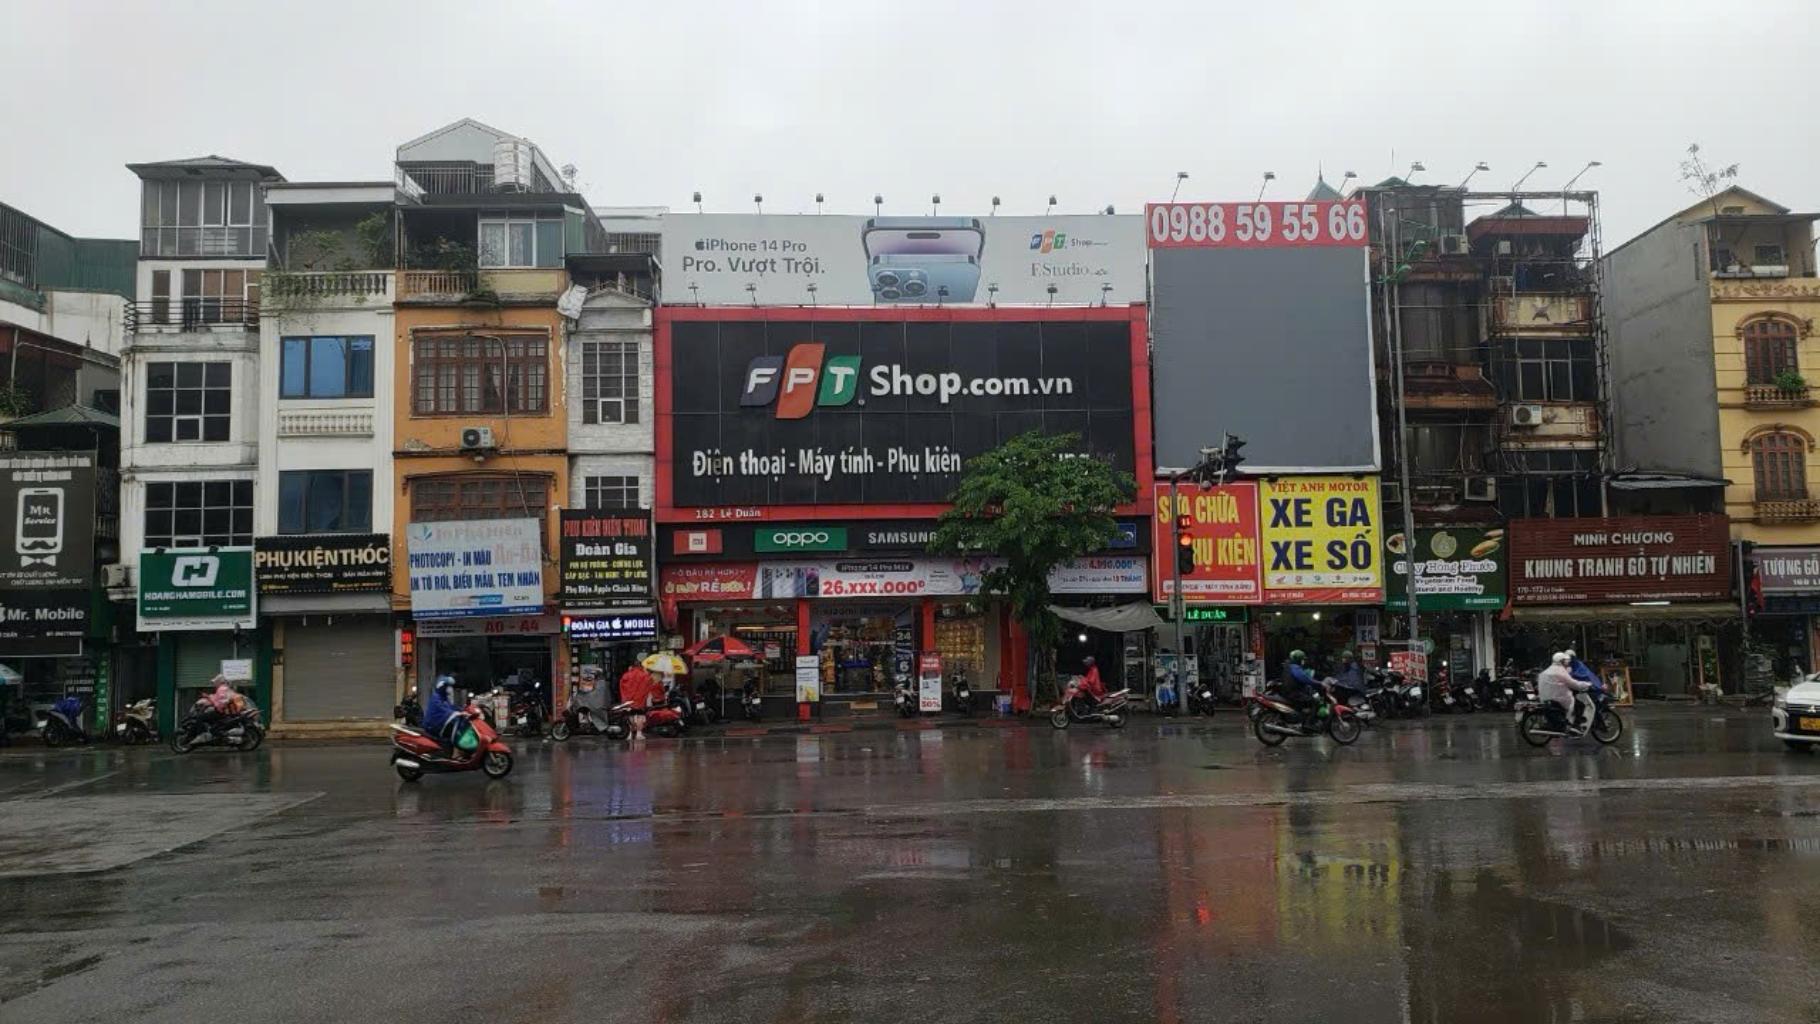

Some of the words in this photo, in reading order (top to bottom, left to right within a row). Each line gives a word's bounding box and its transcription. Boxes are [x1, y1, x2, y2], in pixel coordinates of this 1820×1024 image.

[1151, 205, 1226, 242] 0988
[1235, 204, 1272, 242] 59
[1282, 204, 1319, 241] 55
[1328, 203, 1366, 241] 66
[706, 239, 757, 251] iPhone
[761, 240, 778, 251] 14
[782, 240, 807, 252] Pro
[682, 256, 722, 272] Pro.
[727, 257, 777, 277] Vượt
[782, 257, 825, 278] Trội.
[869, 364, 1073, 404] Shop.com.vn
[692, 450, 734, 484] Điện
[739, 450, 787, 482] thoại
[798, 448, 835, 481] Máy
[840, 448, 874, 474] tính
[888, 448, 920, 480] Phụ
[925, 448, 962, 479] kiện
[1272, 480, 1297, 494] VIỆT
[1300, 483, 1325, 493] ANH
[1328, 482, 1369, 492] MOTOR
[695, 509, 714, 519] 182
[1195, 490, 1240, 524] CHỮA
[1270, 498, 1313, 528] XE
[1326, 497, 1371, 527] GA
[615, 542, 638, 555] Gia
[1573, 533, 1607, 545] MINH
[1611, 532, 1674, 545] CHƯƠNG
[410, 551, 455, 568] PHOTOCOPY
[1217, 532, 1255, 572] KIỆN
[1270, 540, 1314, 571] XE
[1326, 529, 1372, 570] SỐ
[1525, 558, 1573, 578] KHUNG
[1578, 557, 1623, 577] TRANH
[1651, 555, 1670, 581] TỰ
[1672, 551, 1715, 575] NHIÊN
[1762, 557, 1802, 579] TƯỢNG
[497, 573, 514, 588] TEM
[7, 608, 30, 621] Mr.
[35, 607, 85, 620] Mobile
[623, 619, 655, 629] MOBILE
